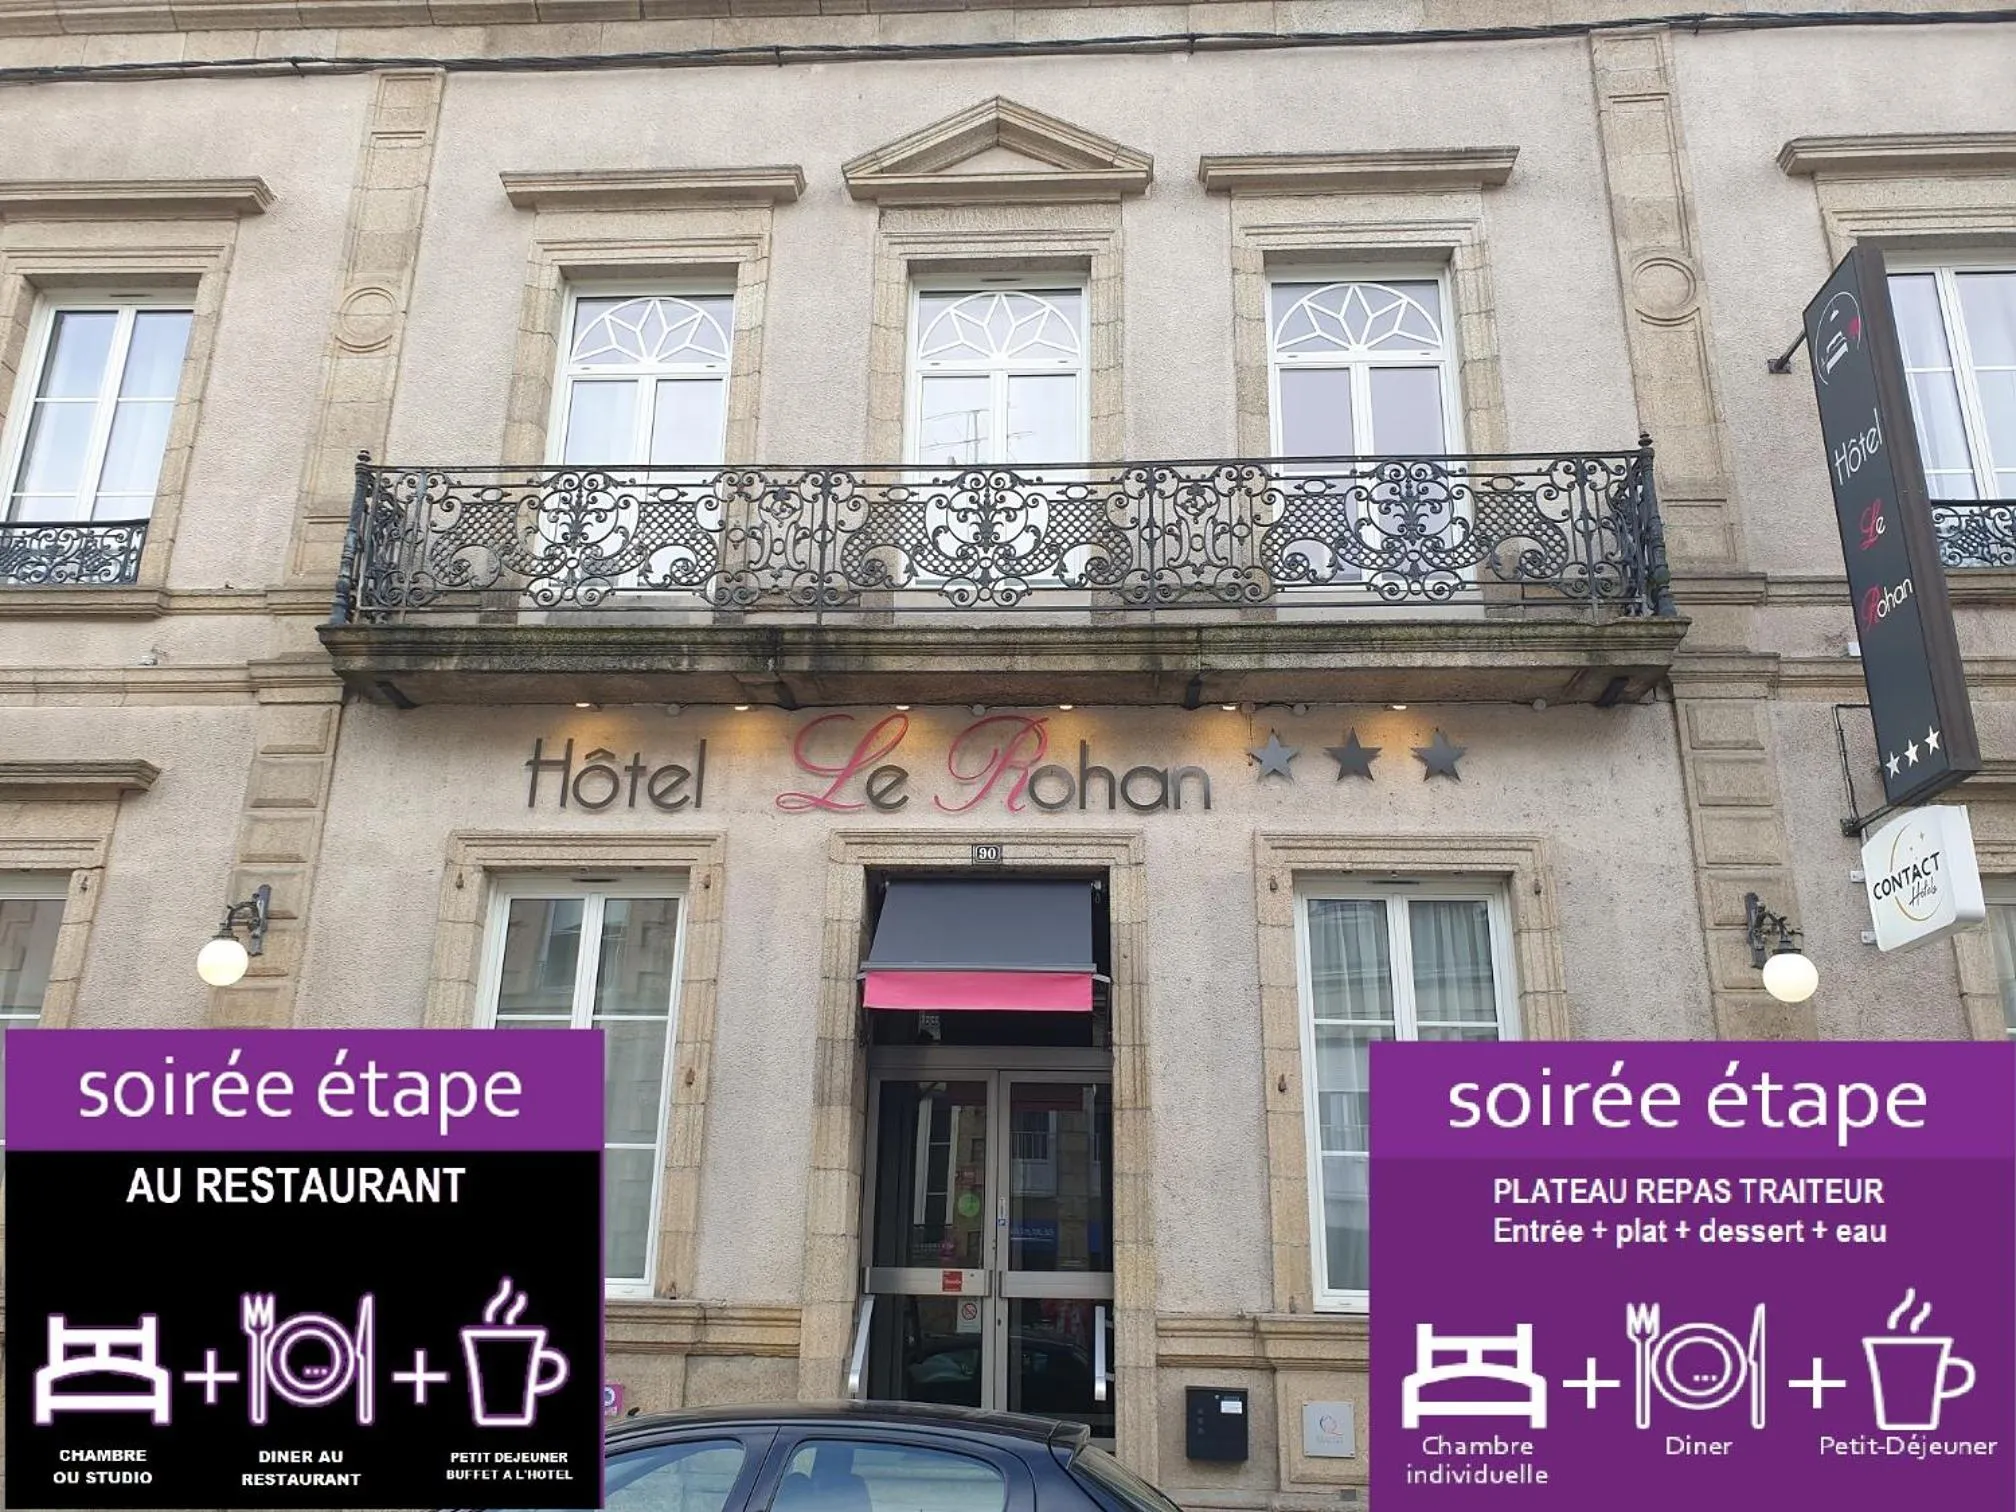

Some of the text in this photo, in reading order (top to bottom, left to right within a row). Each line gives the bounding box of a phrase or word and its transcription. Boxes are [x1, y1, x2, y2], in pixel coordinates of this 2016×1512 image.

[1834, 408, 1882, 485] Hôtel
[1859, 499, 1886, 550] Le
[1861, 578, 1912, 631] Rohan
[526, 713, 1212, 812] Hôtel Le Rohan
[979, 847, 997, 860] 90
[1873, 851, 1940, 900] CONTACT
